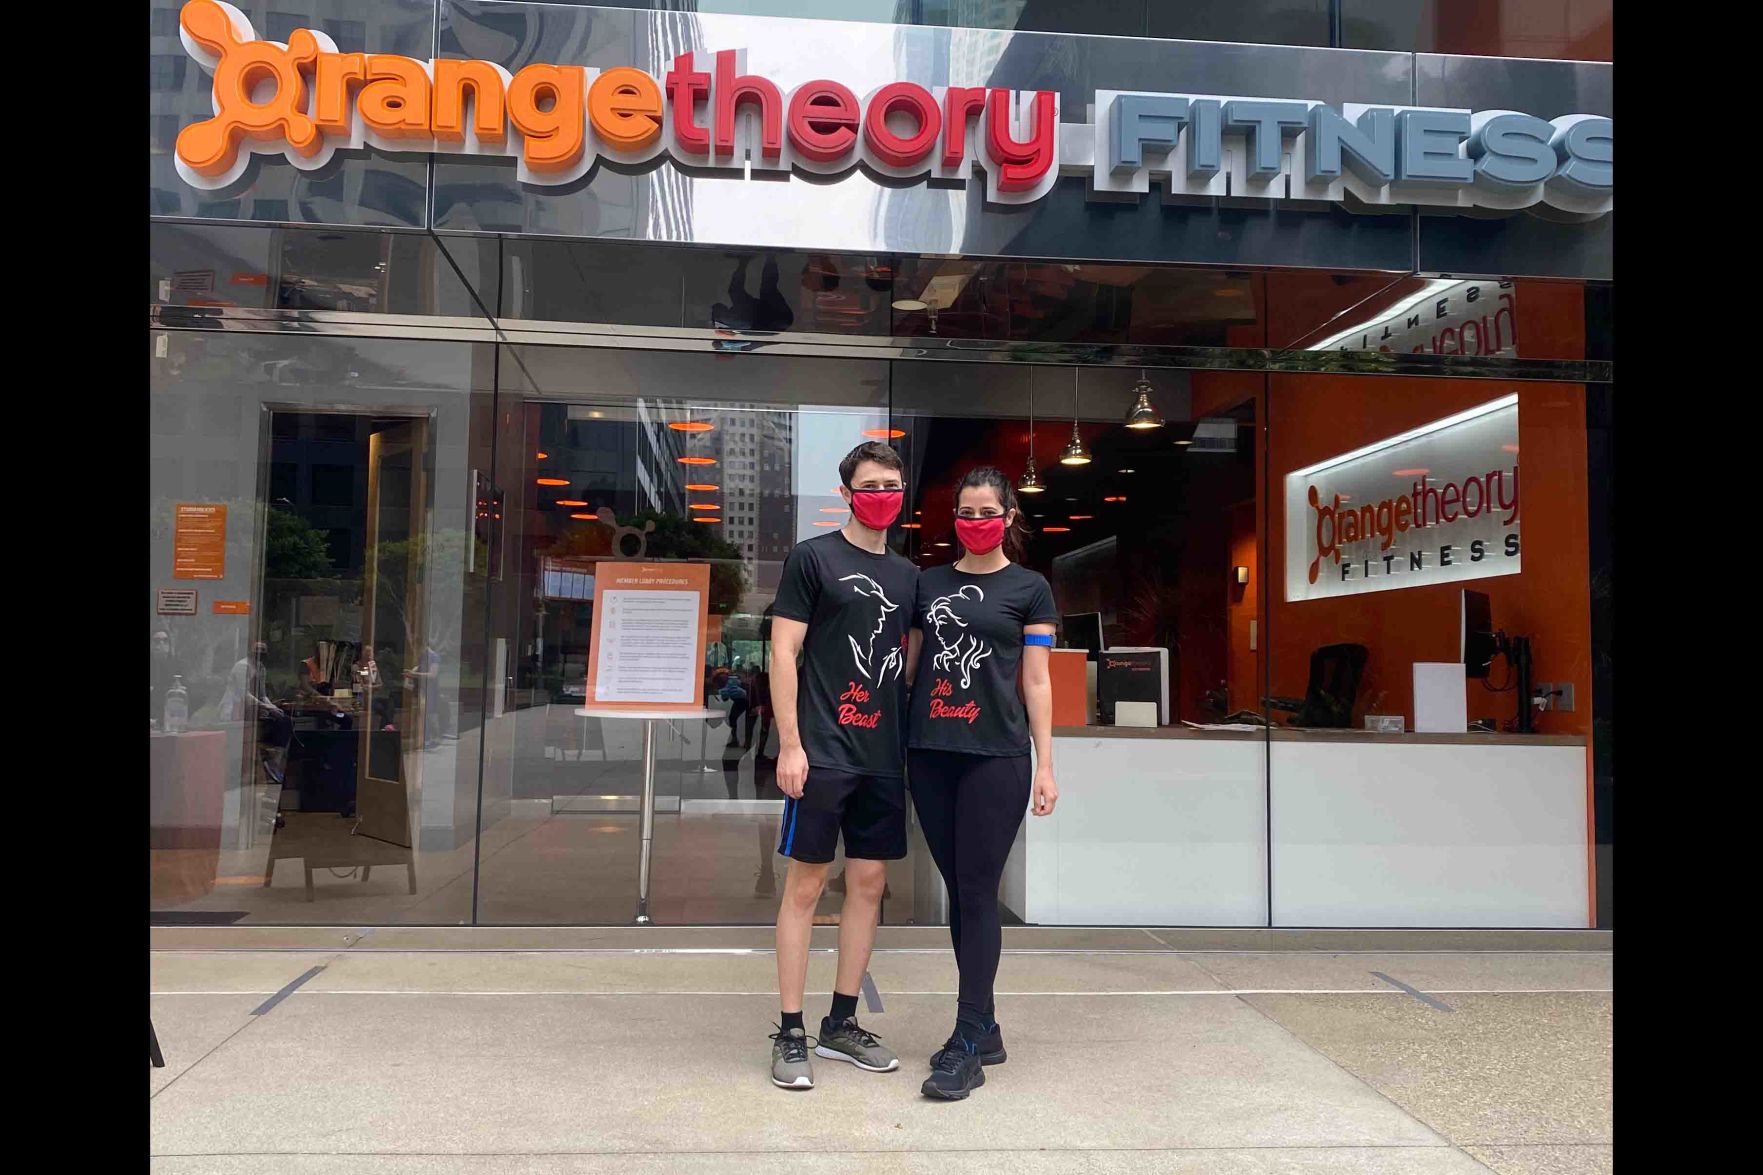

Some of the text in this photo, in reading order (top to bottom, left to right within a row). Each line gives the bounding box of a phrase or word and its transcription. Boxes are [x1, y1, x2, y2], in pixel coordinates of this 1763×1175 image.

[176, 0, 1057, 193] orangetheory
[1307, 465, 1519, 585] orangetheory
[1341, 533, 1521, 581] FITNESS
[840, 681, 870, 703] Her
[930, 678, 953, 696] His
[838, 703, 882, 729] Beast
[929, 698, 981, 724] Beauty
